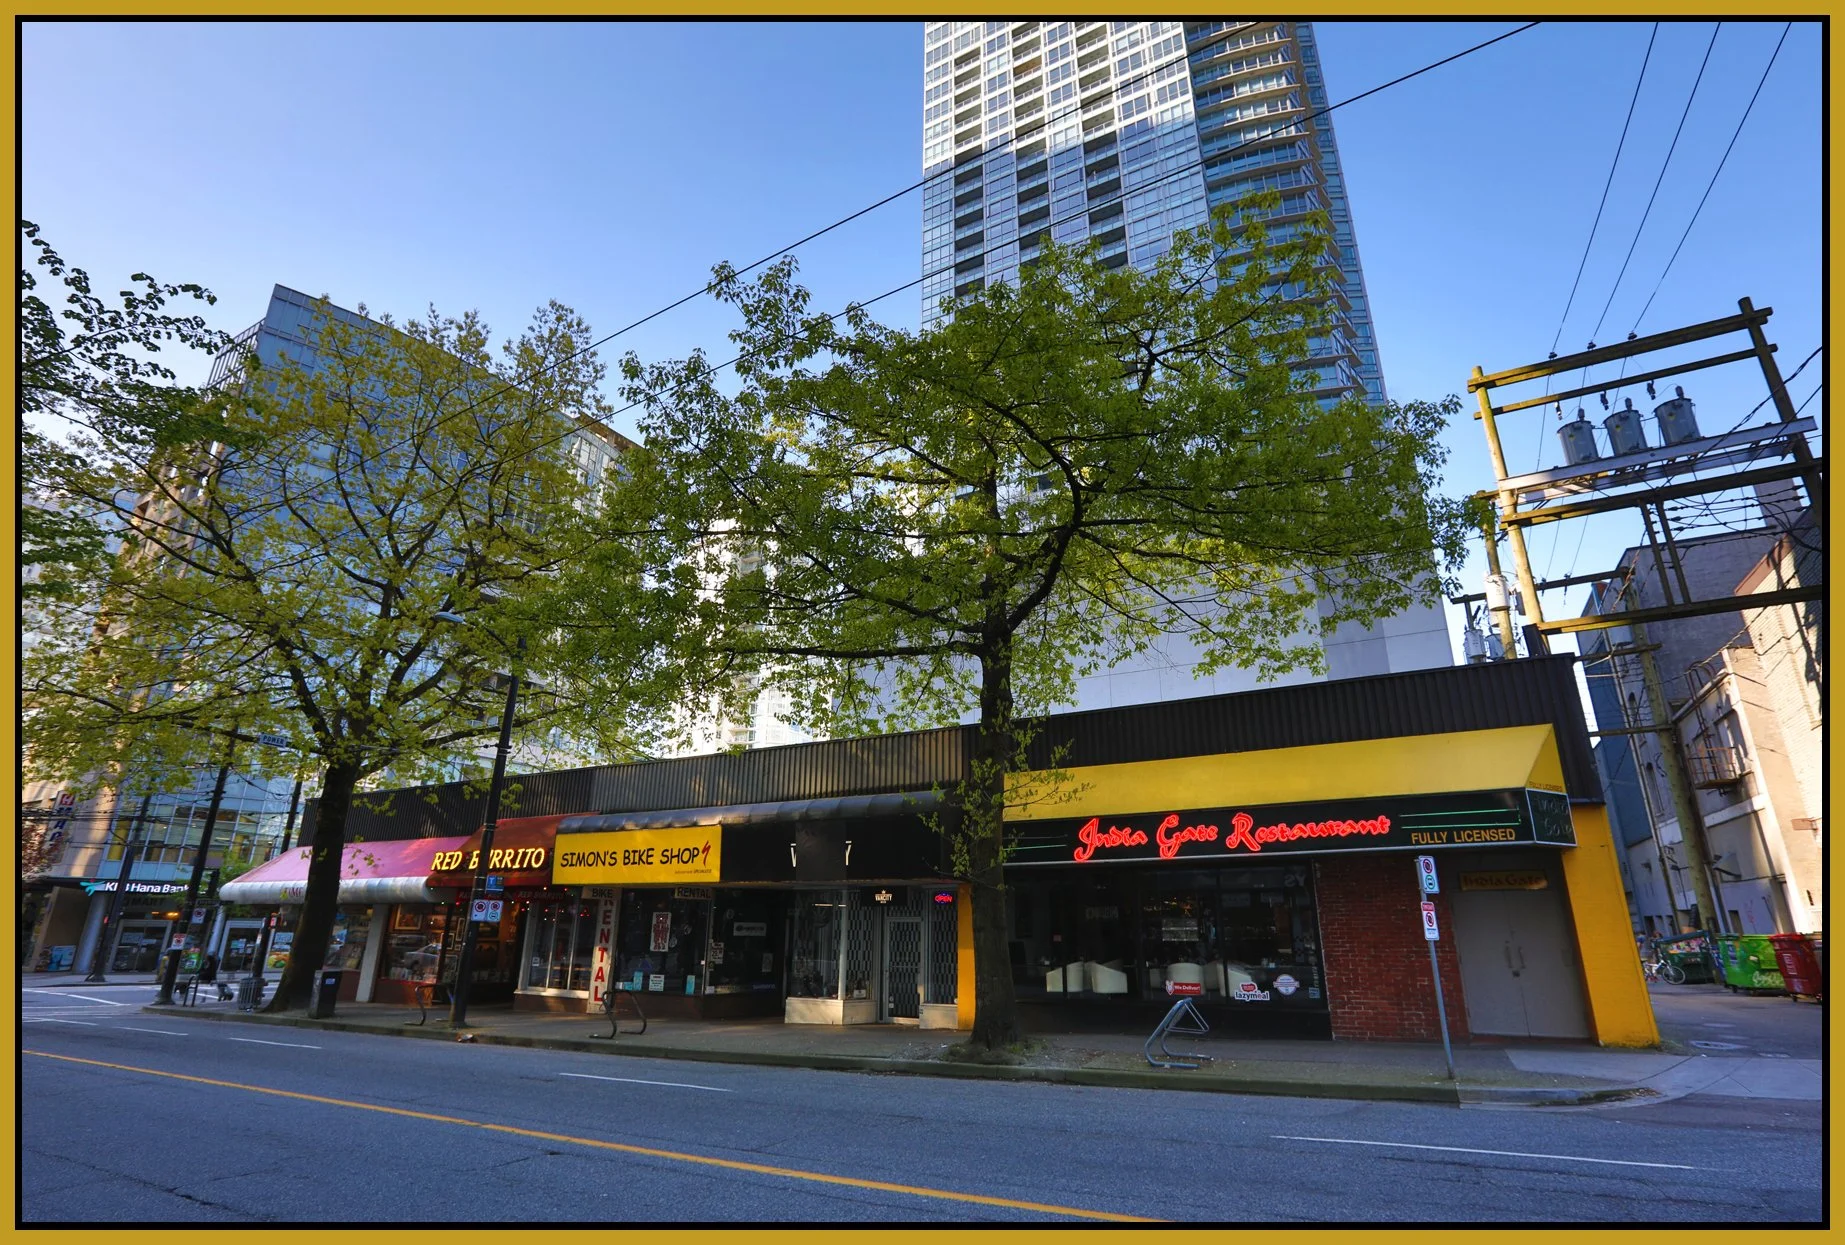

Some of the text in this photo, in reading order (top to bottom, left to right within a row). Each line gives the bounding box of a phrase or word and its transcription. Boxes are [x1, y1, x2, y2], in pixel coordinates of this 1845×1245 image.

[1074, 812, 1391, 862] India Gate Restaurant
[1412, 828, 1516, 845] FULLY LICENSED
[431, 847, 545, 871] RED BRRITO
[560, 847, 700, 868] SIMON'S BIKE SHOP
[131, 883, 160, 893] Hana
[162, 884, 190, 894] Bank
[592, 887, 614, 899] BIKE
[677, 886, 711, 899] RENTAL
[1235, 989, 1269, 1000] lazymeal
